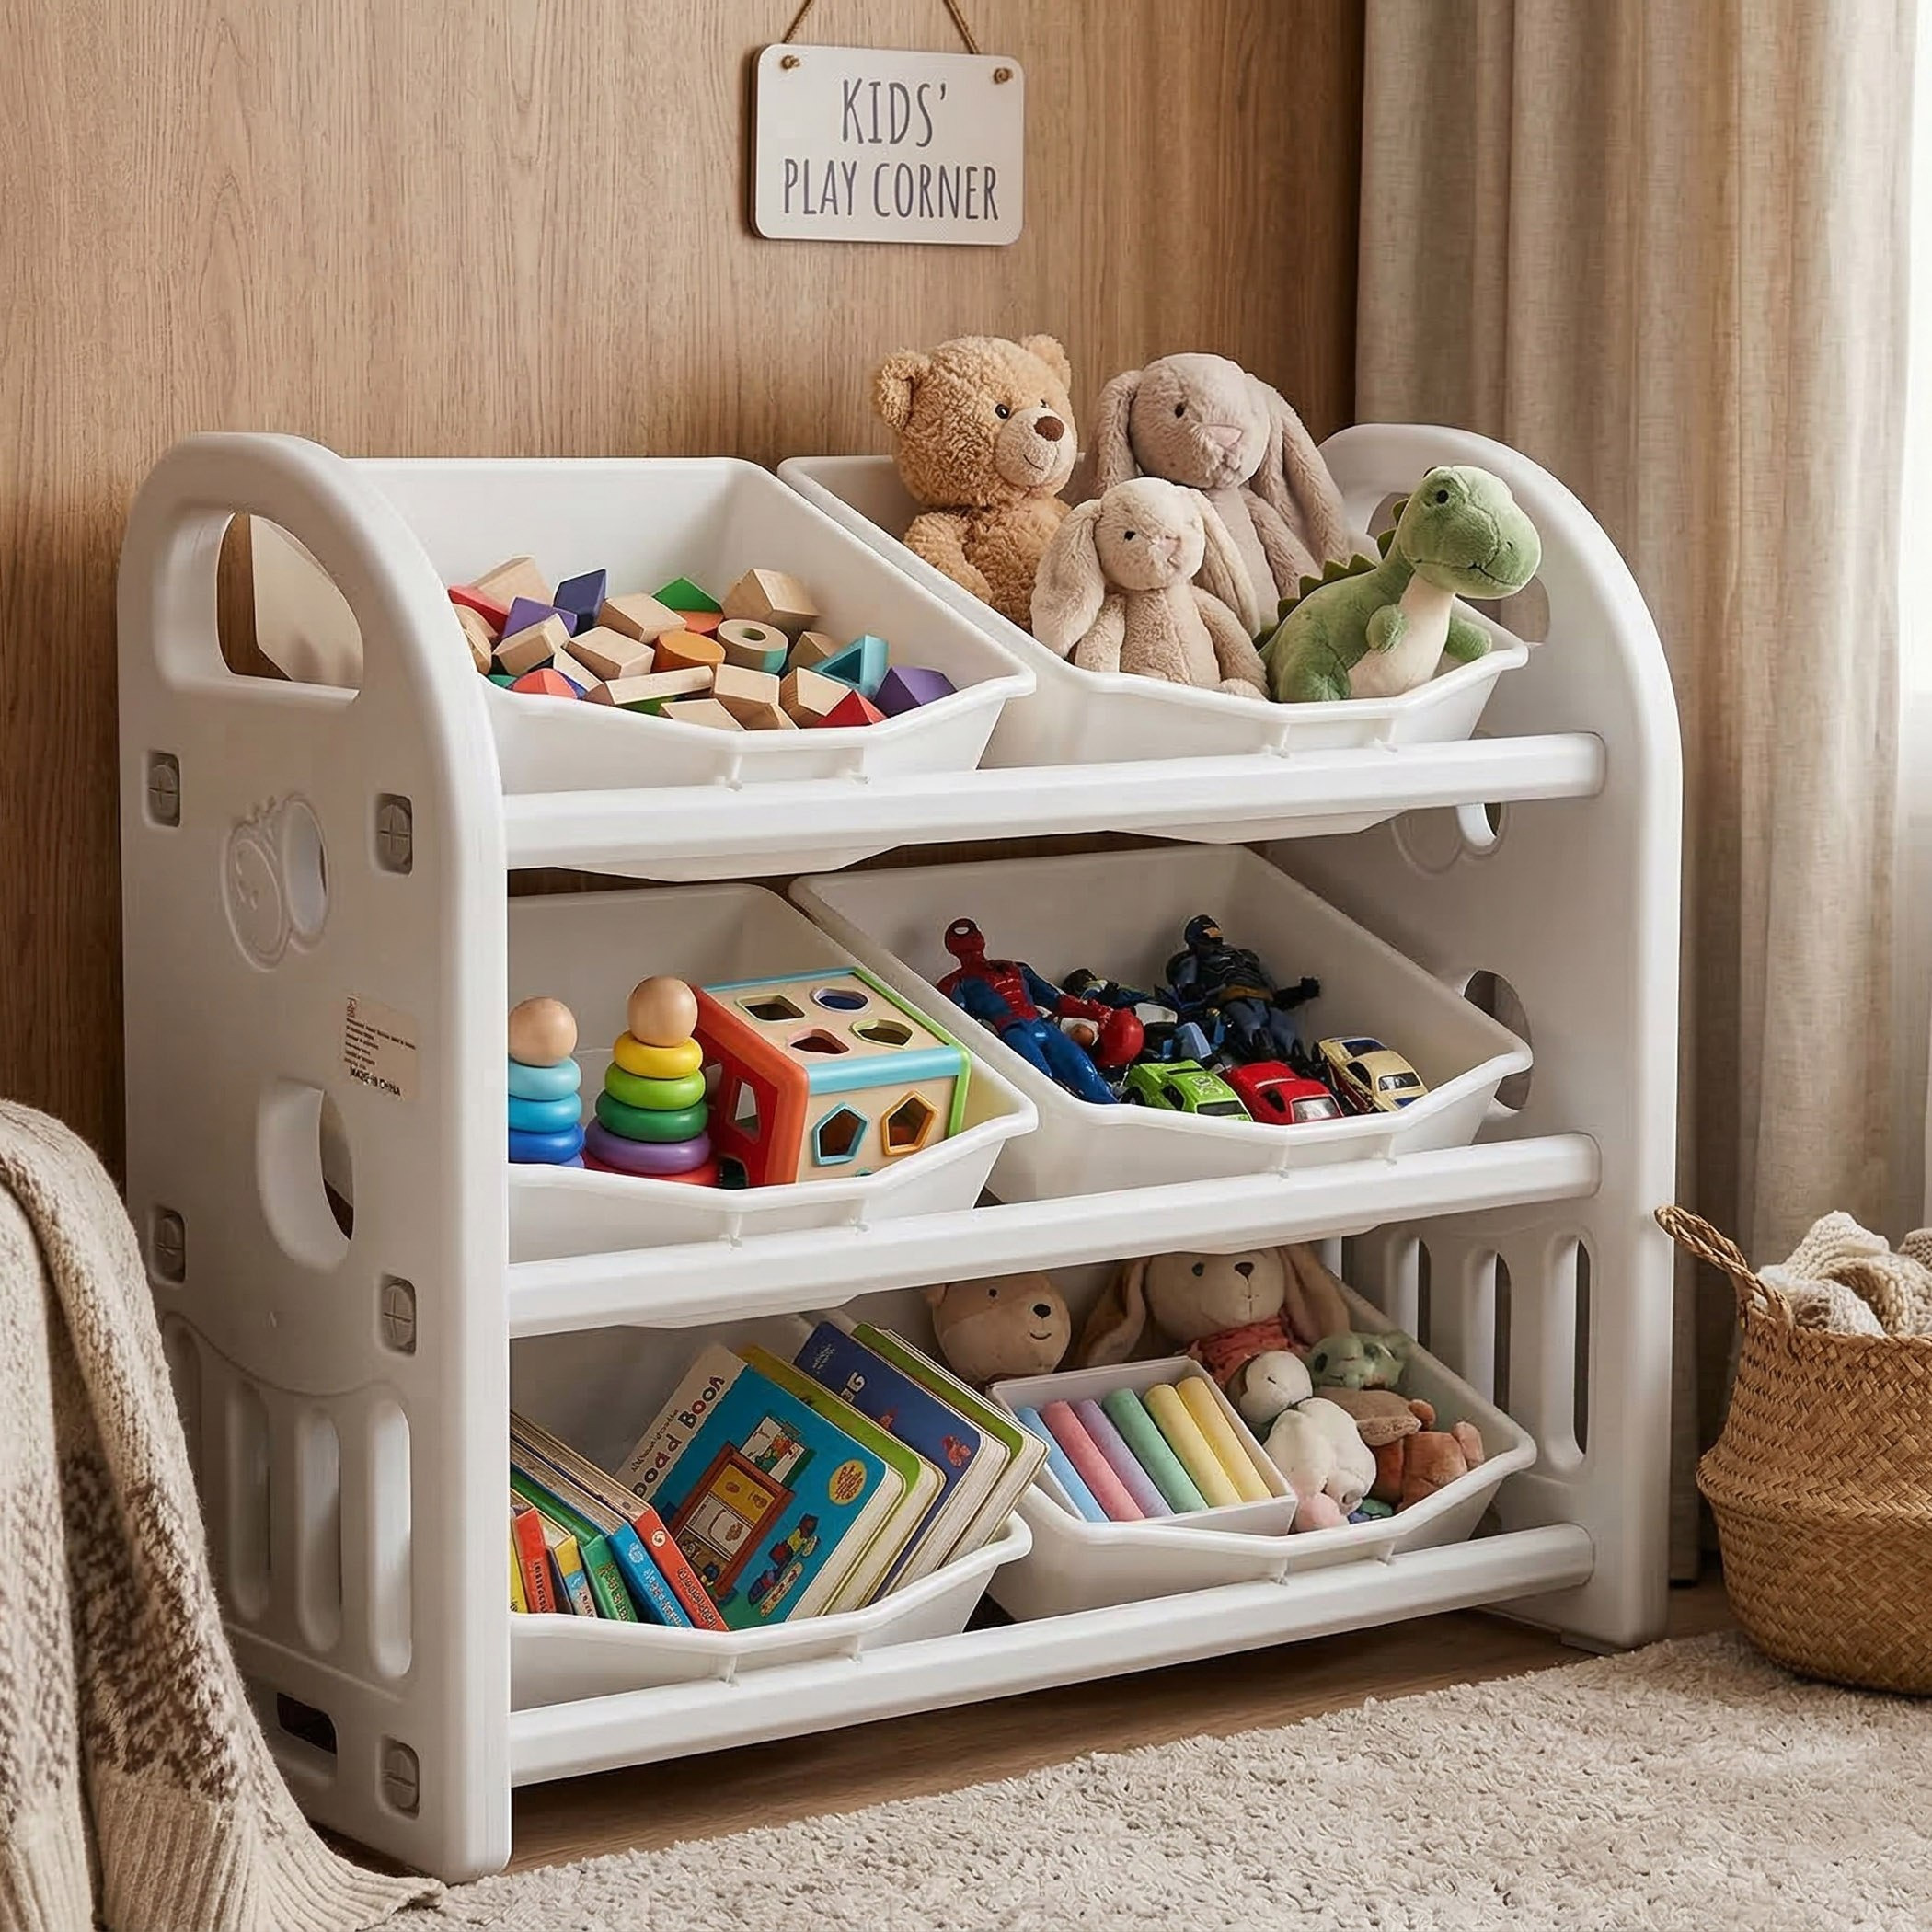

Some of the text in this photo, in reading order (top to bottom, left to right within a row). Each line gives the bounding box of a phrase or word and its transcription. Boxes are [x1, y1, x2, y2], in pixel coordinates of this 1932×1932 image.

[842, 78, 947, 148] KIDS'
[784, 158, 999, 221] PLAY CORNER
